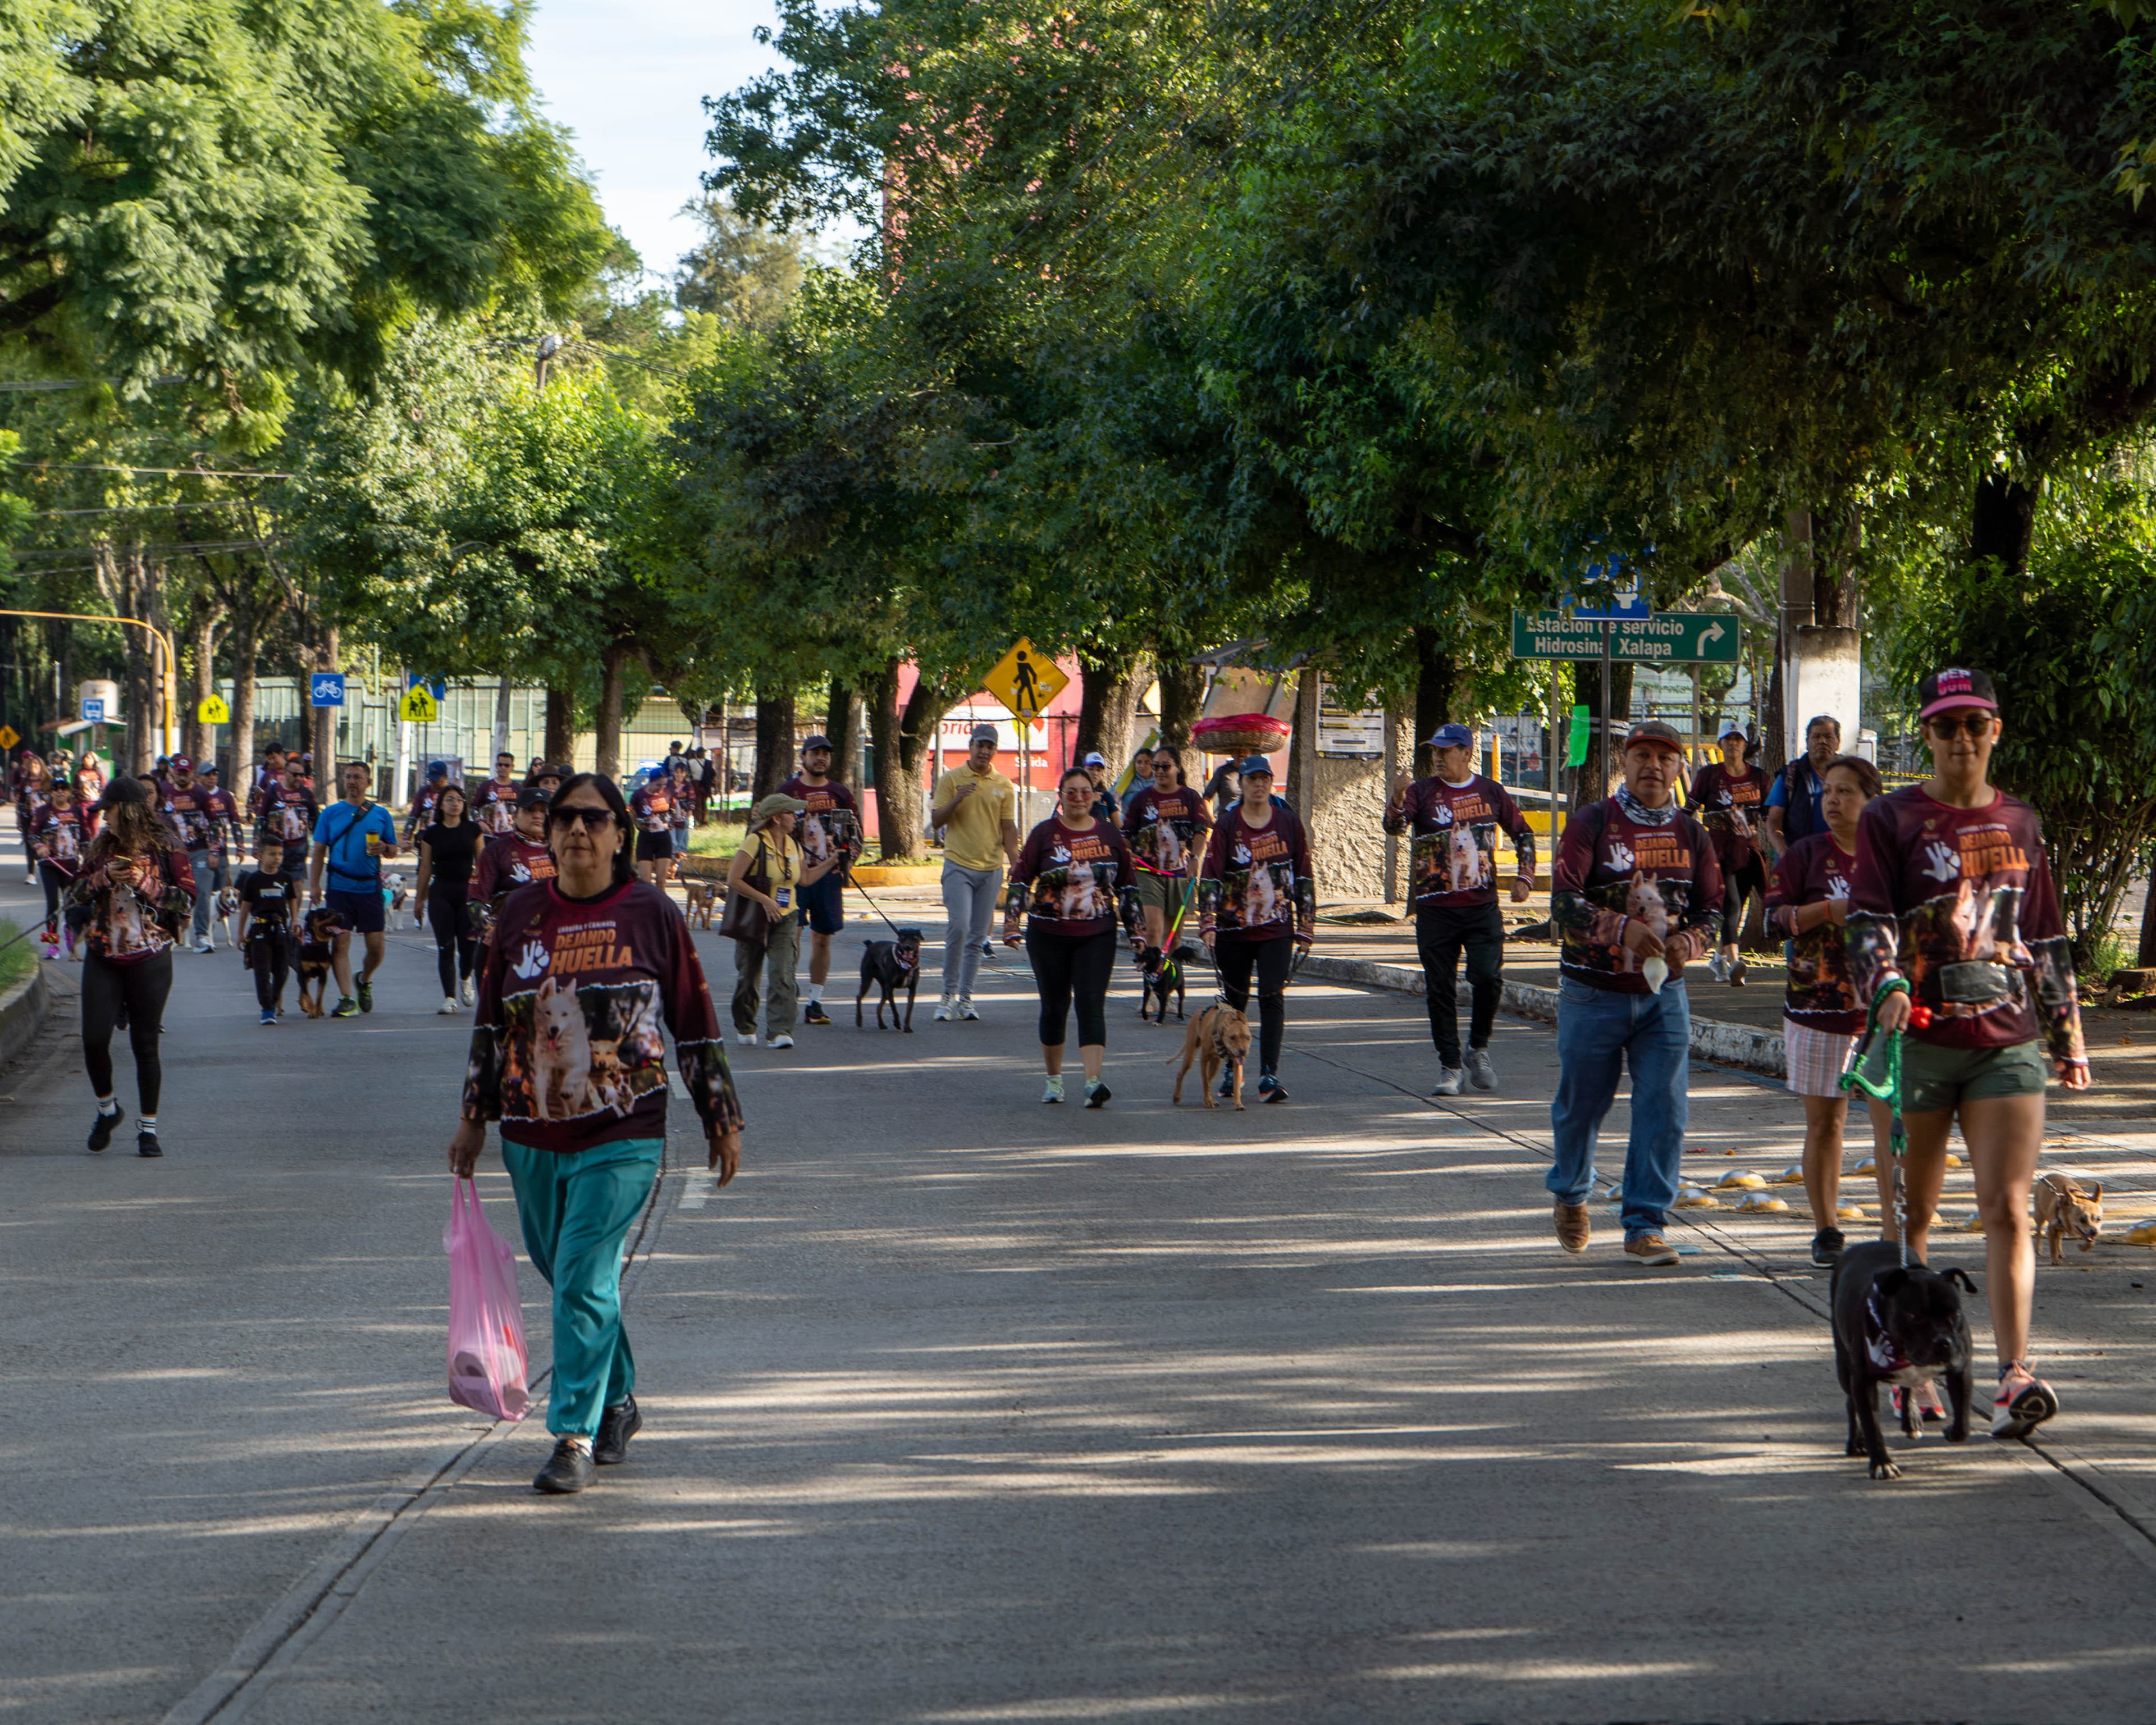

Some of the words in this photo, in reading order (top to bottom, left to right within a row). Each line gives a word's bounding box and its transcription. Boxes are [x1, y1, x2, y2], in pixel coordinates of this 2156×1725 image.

[1621, 619, 1684, 635] servicio
[1619, 638, 1671, 659] Xalapa
[1452, 803, 1492, 820] HUELLA
[1635, 849, 1690, 869] HUELLA
[555, 928, 616, 950] DEJANDO
[547, 945, 633, 975] HUELLA
